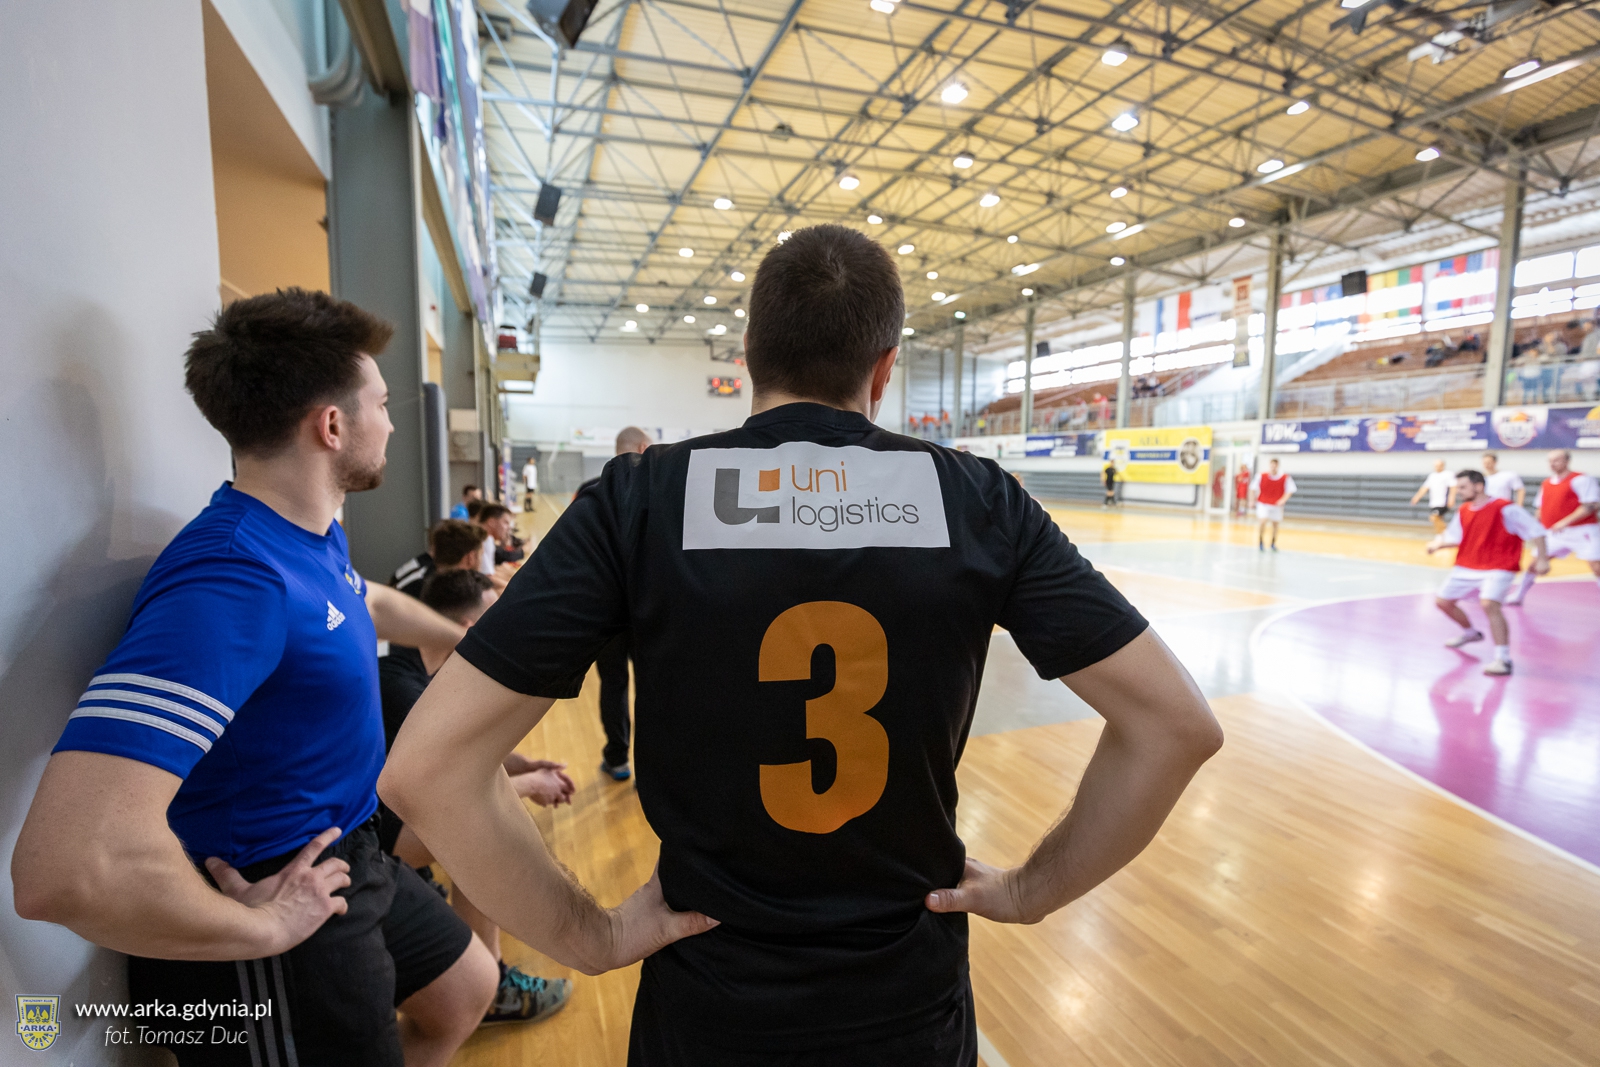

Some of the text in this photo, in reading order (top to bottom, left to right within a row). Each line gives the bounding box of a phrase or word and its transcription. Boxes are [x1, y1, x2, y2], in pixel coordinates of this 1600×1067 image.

[791, 460, 848, 493] uni
[792, 496, 920, 532] logistics
[758, 600, 890, 835] 3
